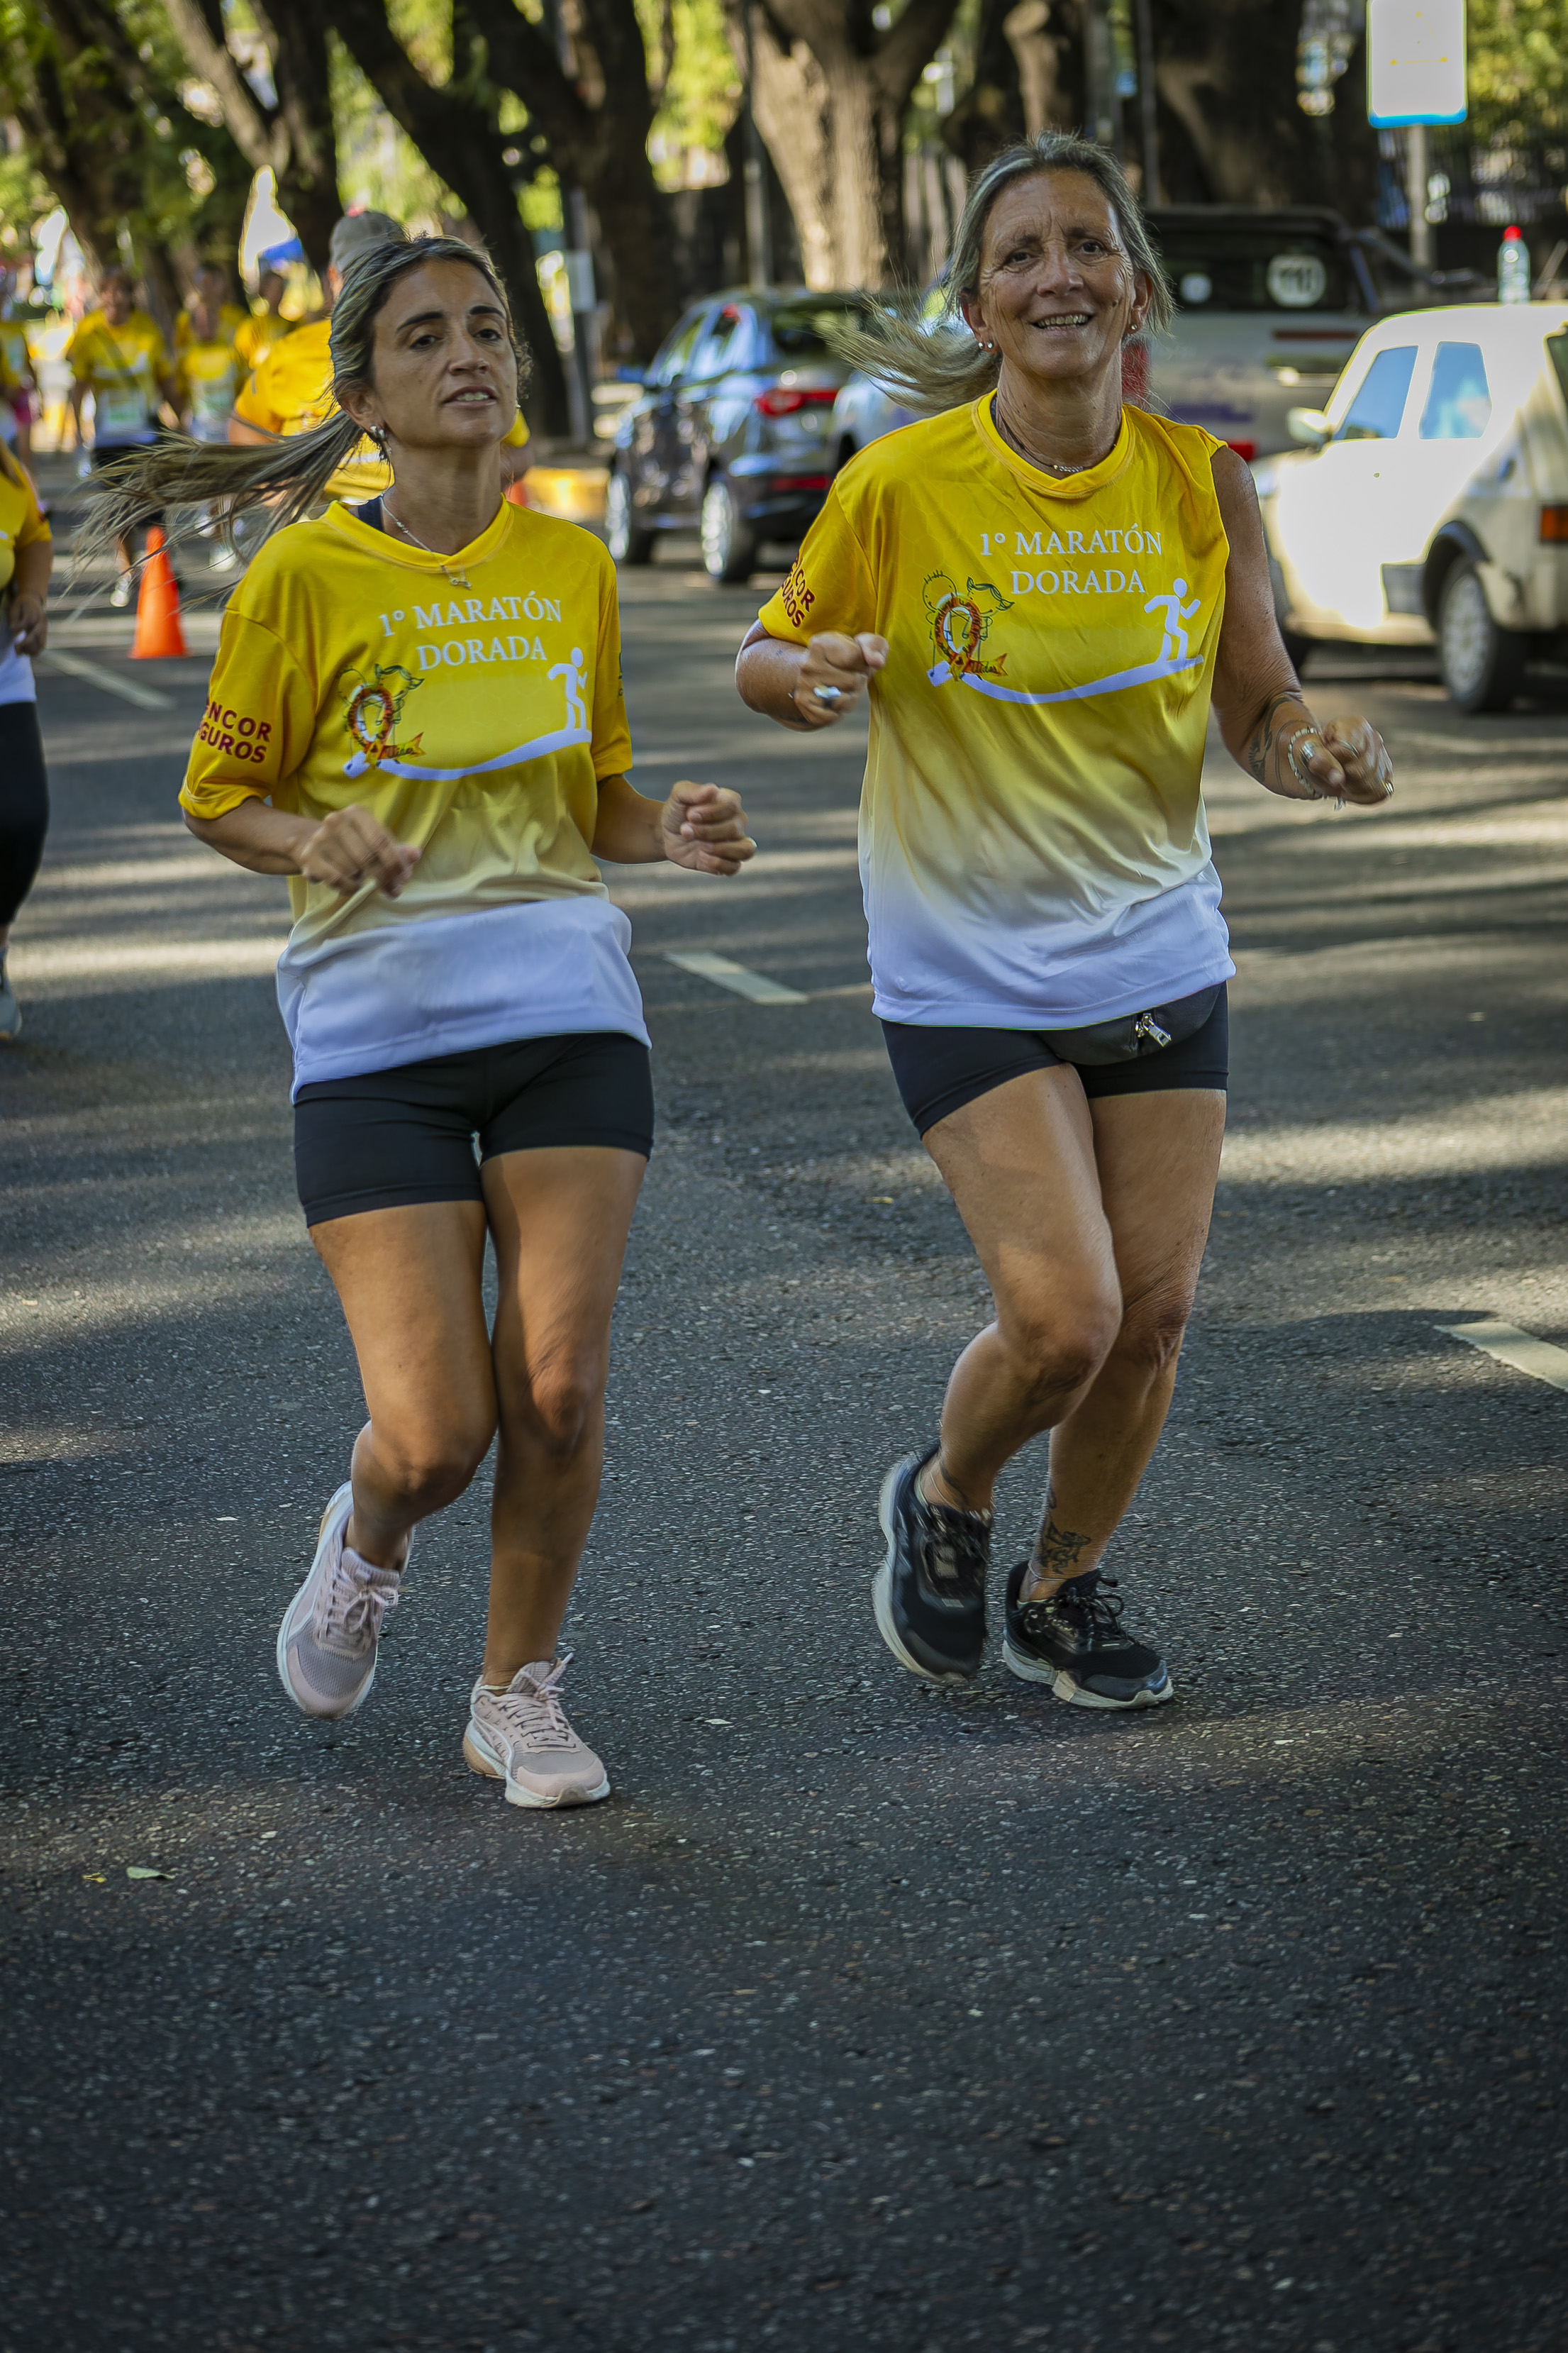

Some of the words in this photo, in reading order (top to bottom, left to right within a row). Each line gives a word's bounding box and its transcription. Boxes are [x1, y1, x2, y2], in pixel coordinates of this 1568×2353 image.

[1014, 523, 1162, 555] MARATÓN
[1011, 569, 1145, 594] DORADA
[411, 590, 562, 630] MARATÓN
[416, 636, 547, 671] DORADA
